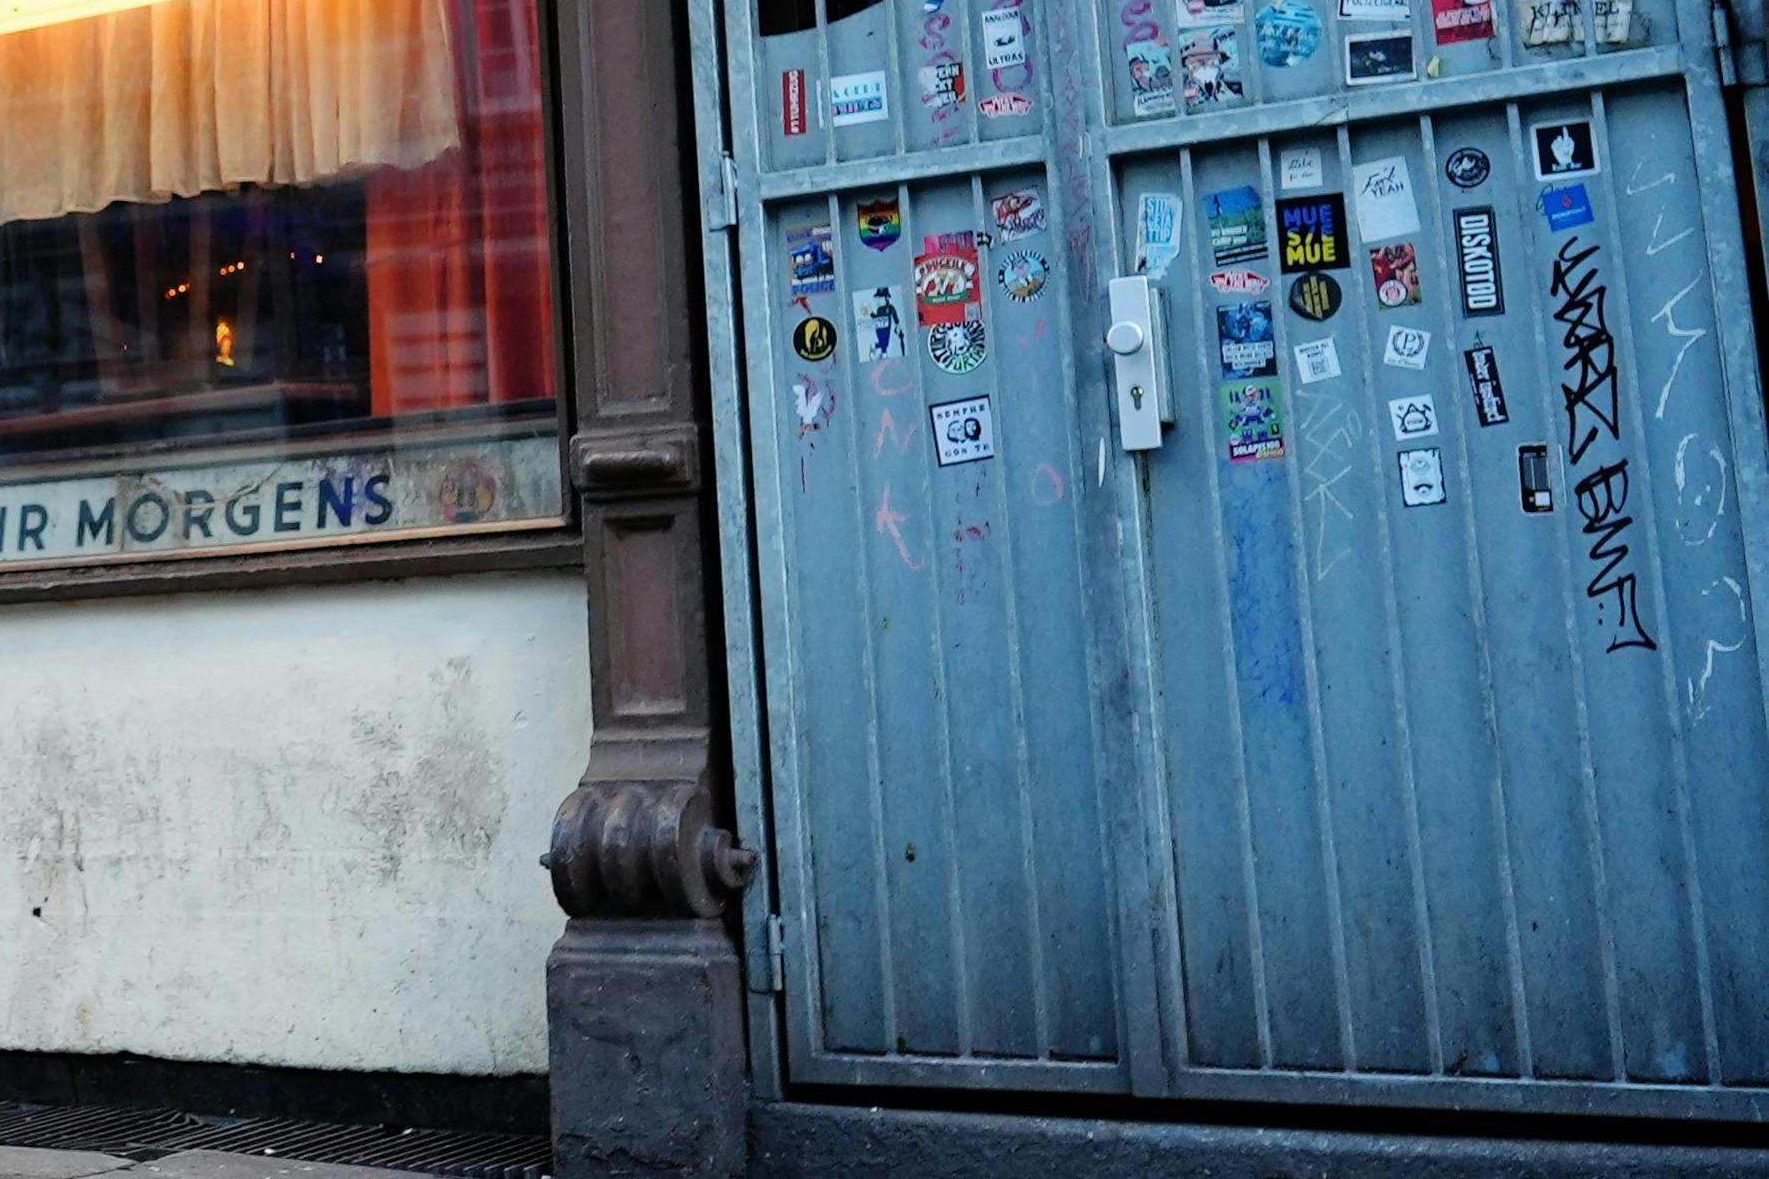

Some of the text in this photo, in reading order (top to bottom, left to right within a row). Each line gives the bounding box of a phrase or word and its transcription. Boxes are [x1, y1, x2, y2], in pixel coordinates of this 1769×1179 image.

[1370, 182, 1404, 198] YEAH
[1286, 242, 1336, 266] MUE
[76, 474, 395, 548] MORGENS
